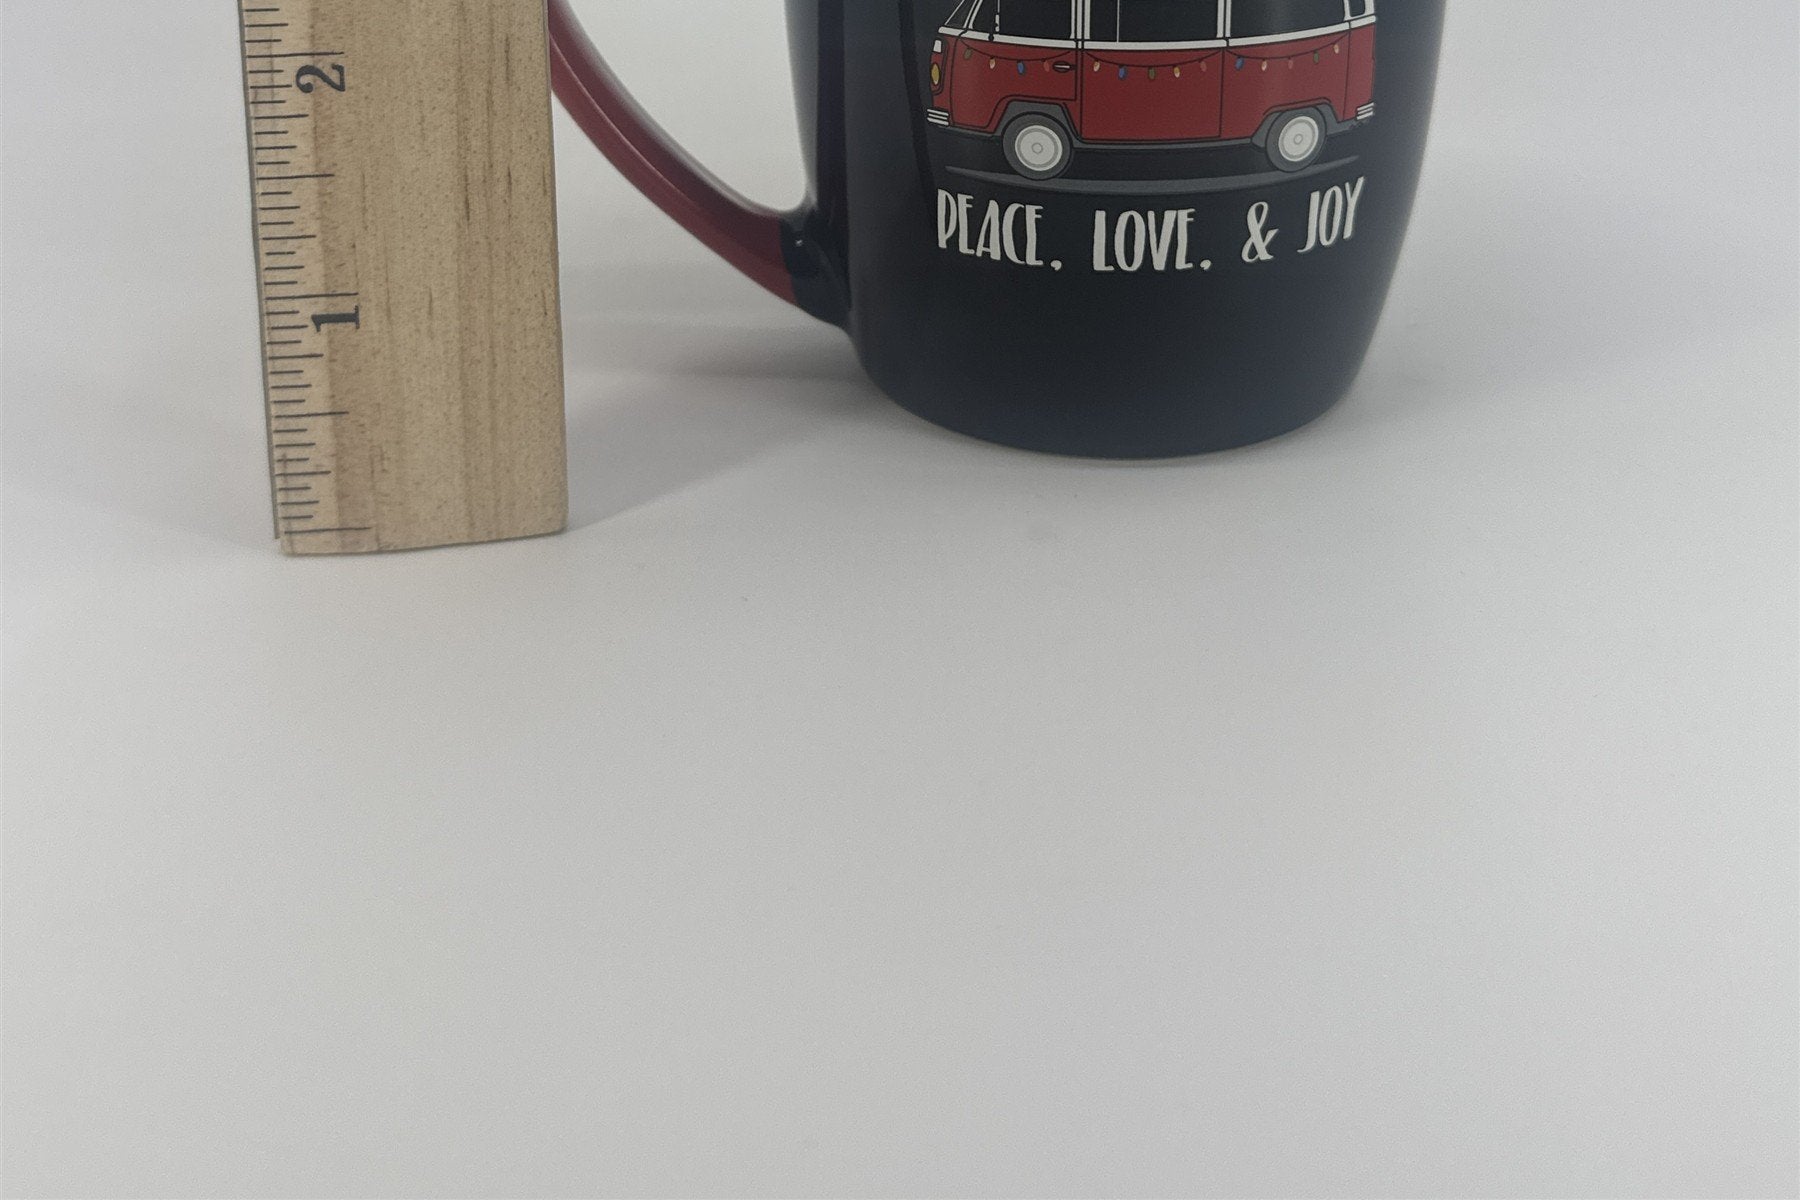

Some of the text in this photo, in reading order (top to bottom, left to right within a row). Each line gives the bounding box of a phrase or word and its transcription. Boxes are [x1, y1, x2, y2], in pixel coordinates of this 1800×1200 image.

[294, 63, 346, 94] 2
[937, 176, 1366, 272] PEACE, LOVE, & JOY
[310, 305, 360, 333] 1
